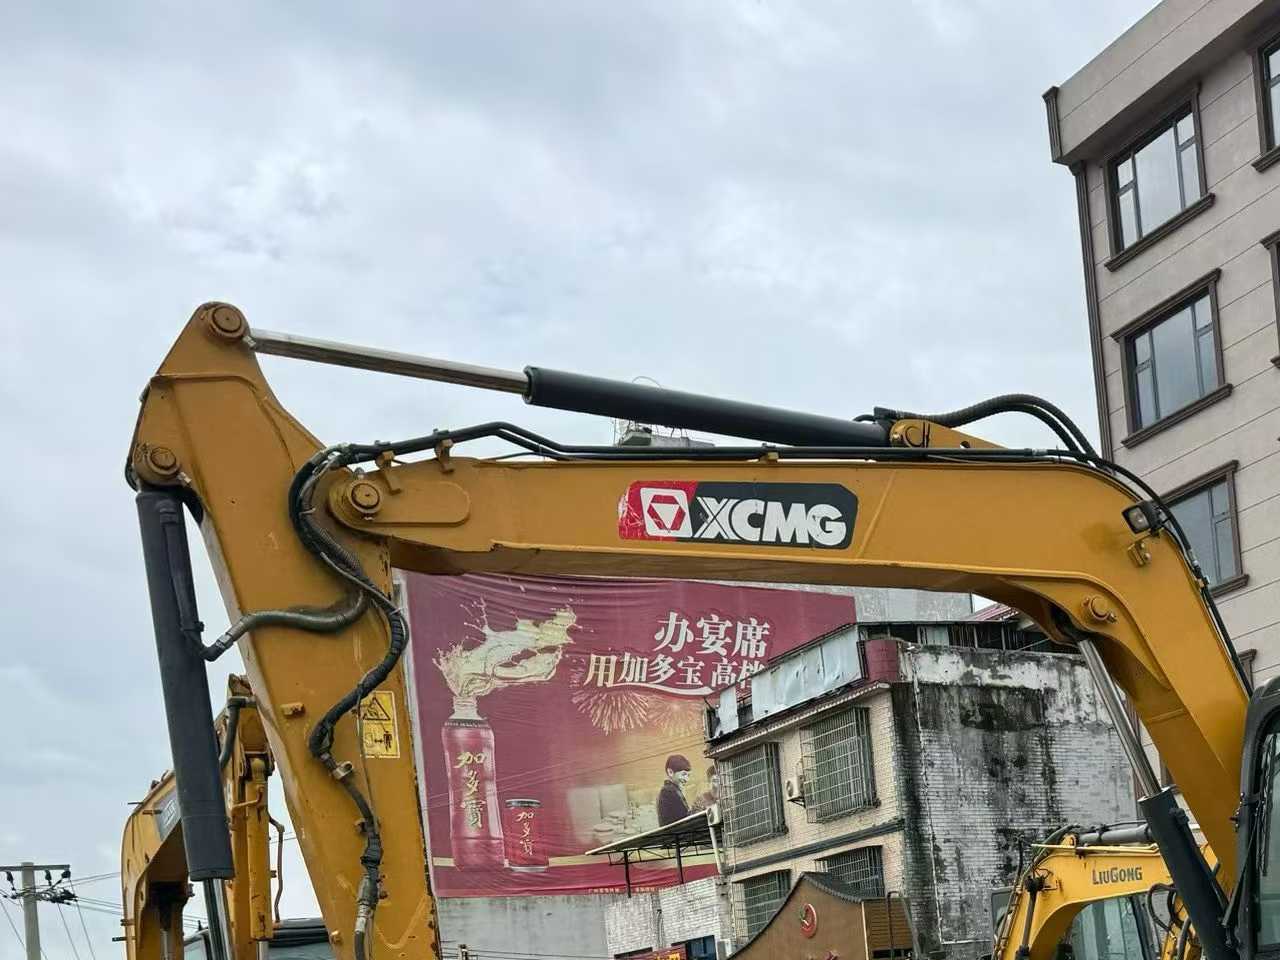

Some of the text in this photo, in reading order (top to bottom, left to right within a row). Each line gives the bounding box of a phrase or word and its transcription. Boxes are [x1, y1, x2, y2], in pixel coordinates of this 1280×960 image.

[694, 495, 848, 547] XCMG
[654, 611, 770, 659] 办宴席
[583, 653, 704, 688] 用加多宝
